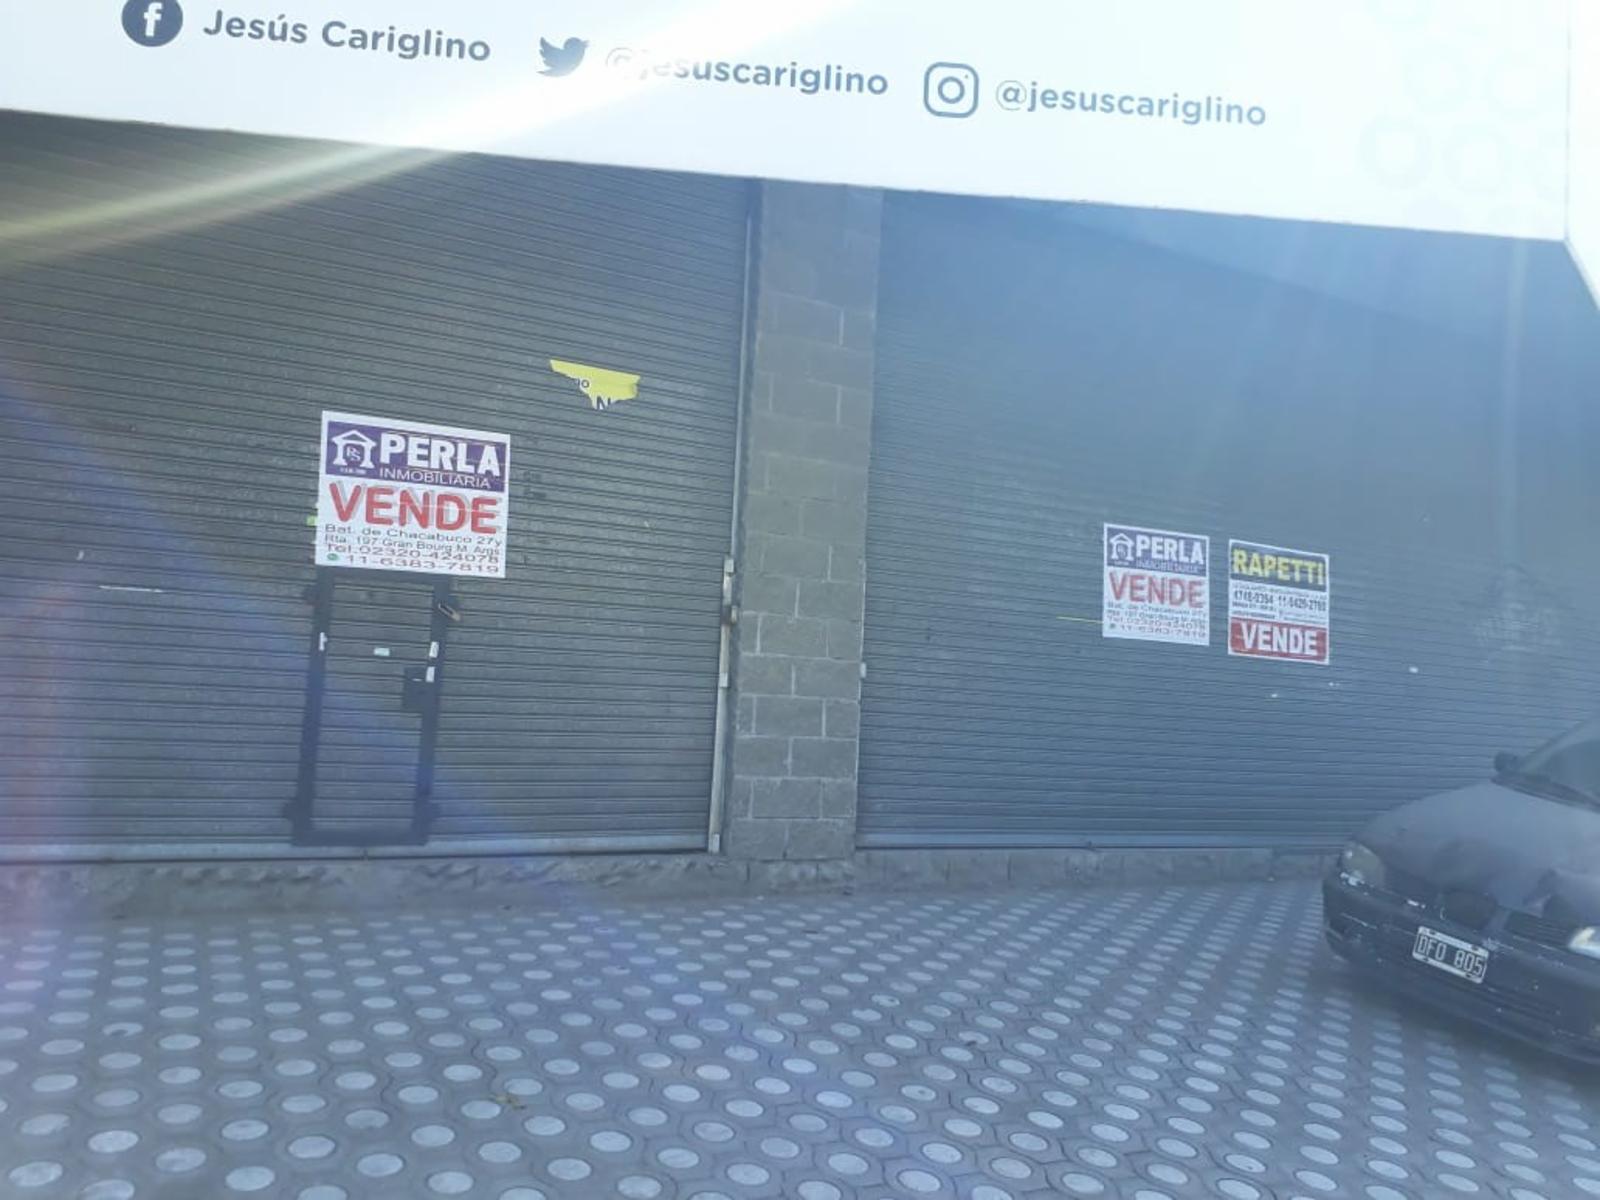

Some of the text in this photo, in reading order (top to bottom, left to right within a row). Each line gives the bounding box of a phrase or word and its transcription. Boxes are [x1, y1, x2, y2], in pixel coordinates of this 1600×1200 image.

[203, 9, 491, 62] Jesús Cariglino
[995, 79, 1267, 127] @jesuscariglino
[379, 432, 501, 477] PERLA
[379, 467, 492, 489] INMOBILIARIA
[329, 481, 499, 535] VENDE
[361, 527, 382, 536] de
[386, 528, 472, 544] Chacabuco
[382, 538, 413, 549] Gran
[416, 541, 453, 553] Bourg
[1135, 533, 1204, 565] PERLA
[1232, 549, 1325, 586] RAPETTI
[1109, 570, 1206, 609] VENDE
[1241, 621, 1318, 656] VENDE
[1454, 950, 1482, 976] 805
